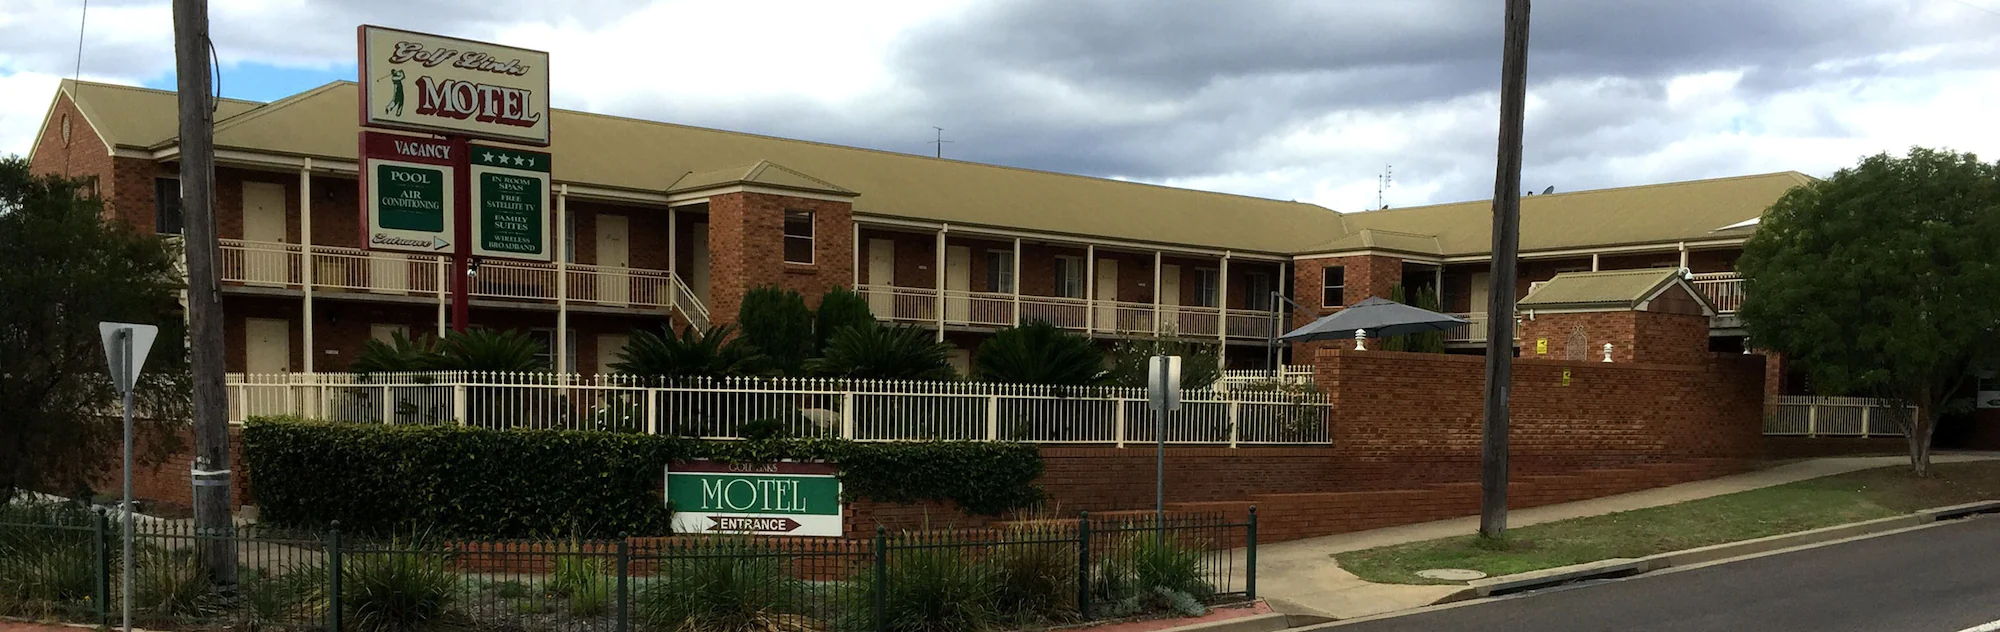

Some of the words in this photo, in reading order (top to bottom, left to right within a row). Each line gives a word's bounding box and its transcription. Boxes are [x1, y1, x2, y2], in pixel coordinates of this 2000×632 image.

[389, 41, 457, 68] Golf
[453, 52, 530, 76] Links
[415, 75, 541, 127] MOTEL
[394, 140, 450, 159] VACANCY
[391, 171, 430, 184] POOL
[505, 177, 531, 186] ROOM
[499, 183, 524, 191] SPAS
[400, 190, 421, 199] AIR
[501, 194, 521, 202] FREE
[382, 197, 439, 210] CONDITIONING
[487, 201, 523, 211] SATELLITE
[495, 215, 528, 223] FAMILY
[495, 222, 528, 231] SUITES
[372, 233, 432, 248] Entrance
[494, 235, 531, 243] WIRELESS
[489, 241, 535, 251] BROADBAND
[701, 478, 806, 512] MOTEL
[720, 518, 787, 531] ENTRANCE
